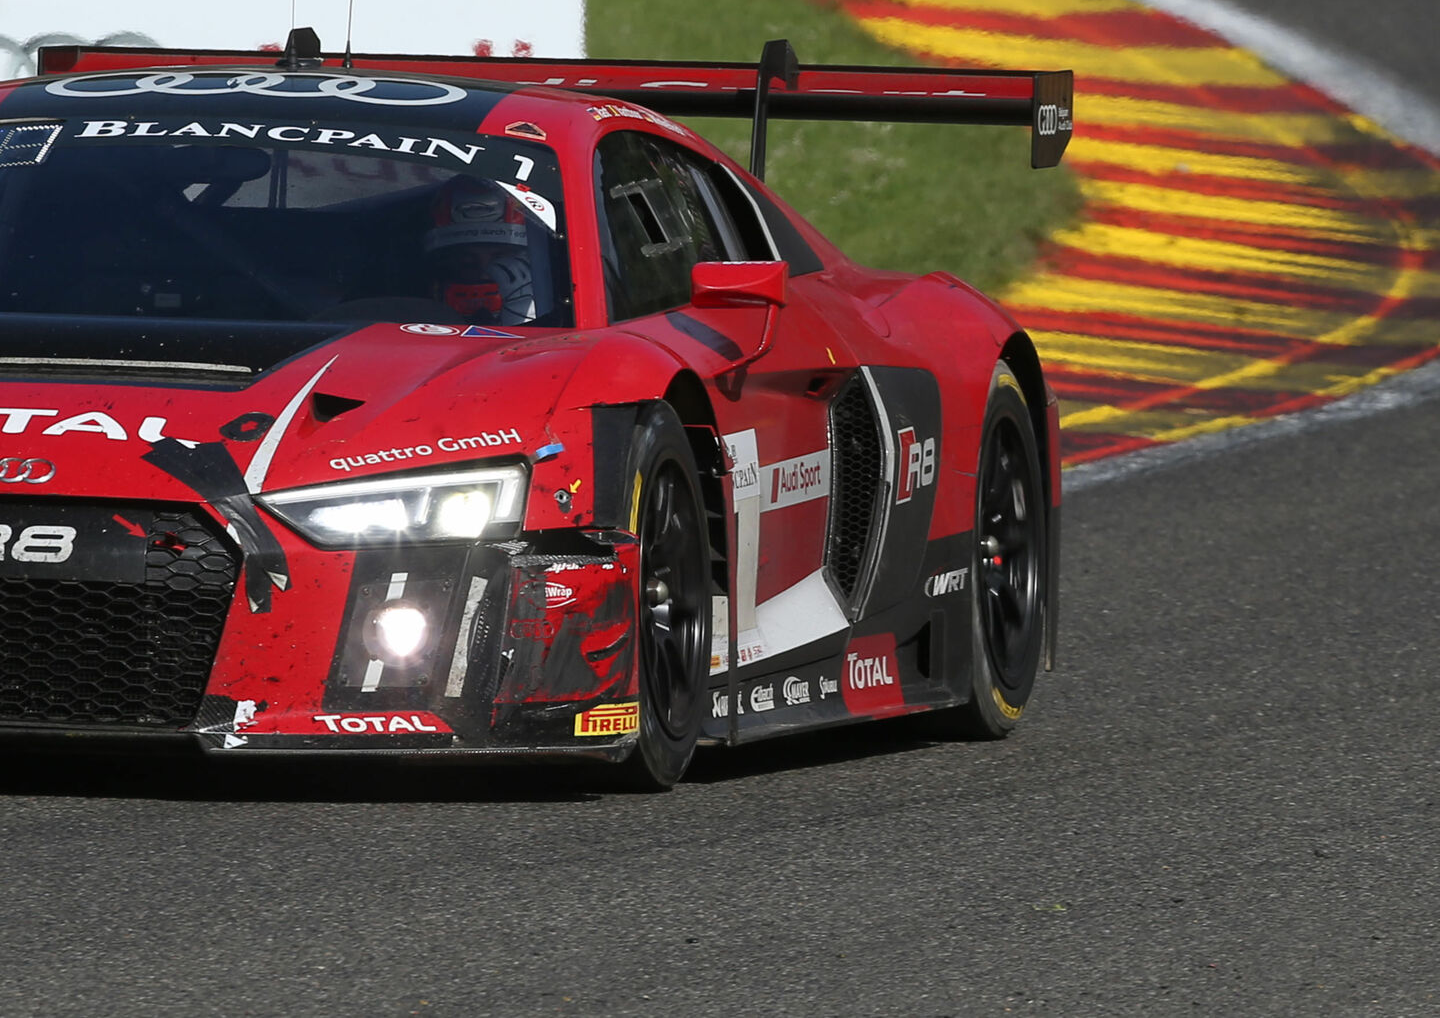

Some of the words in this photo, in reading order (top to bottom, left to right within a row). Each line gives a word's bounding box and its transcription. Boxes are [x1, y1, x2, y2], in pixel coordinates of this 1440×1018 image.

[74, 119, 487, 165] BLANCPAIN
[329, 443, 433, 472] quattro
[436, 428, 523, 453] GmbH
[781, 463, 798, 494] Audi
[799, 461, 821, 495] Sport
[932, 567, 969, 597] WRT
[847, 652, 894, 690] TOTAL
[314, 714, 437, 733] TOTAL
[580, 707, 638, 733] PIRELLI
